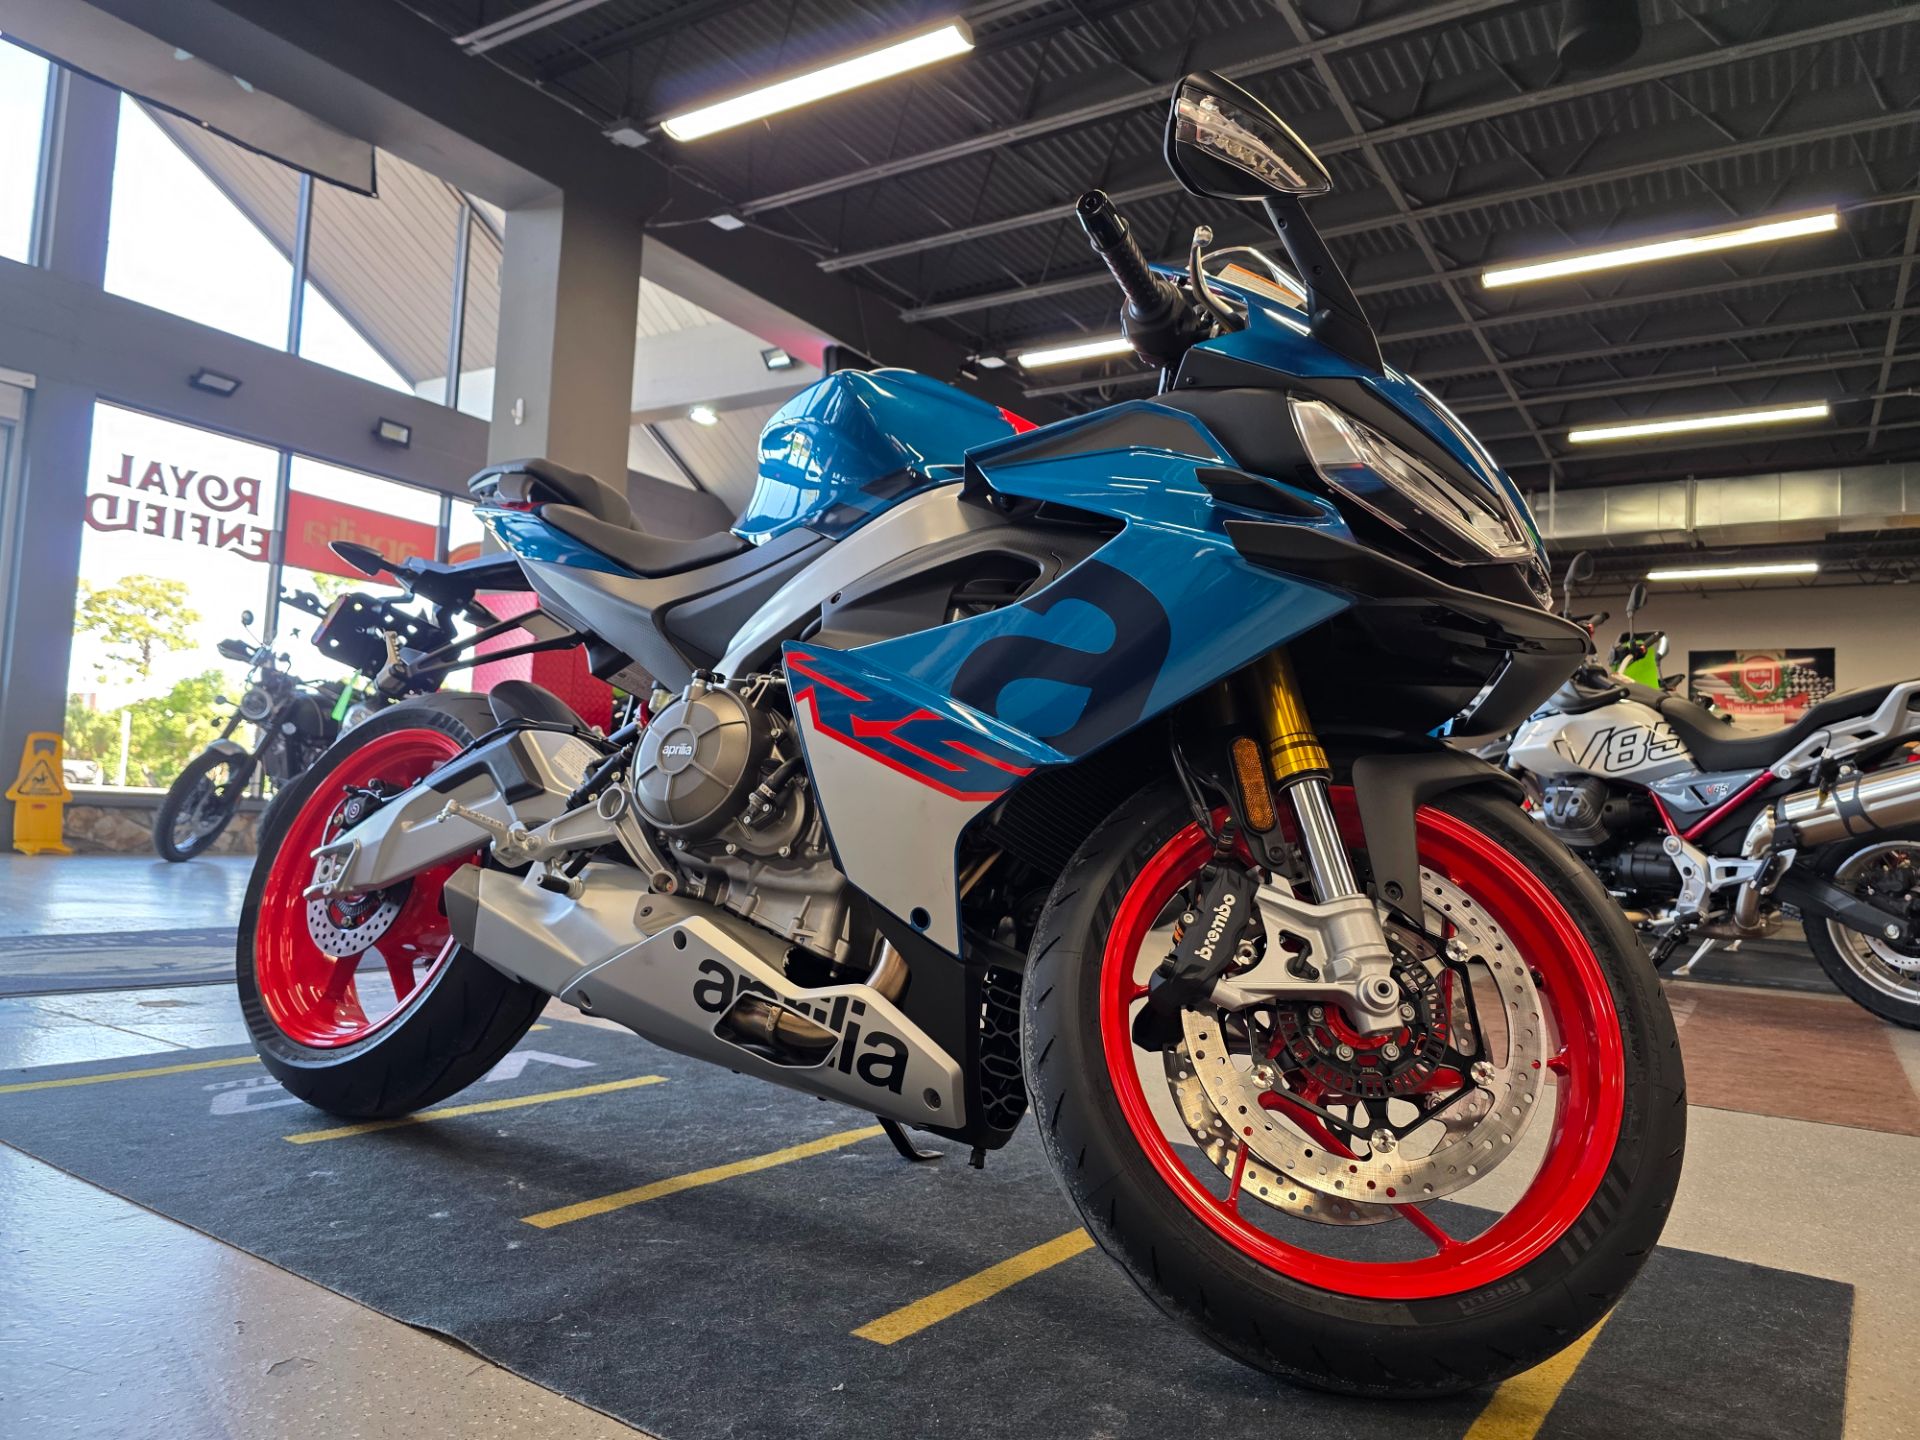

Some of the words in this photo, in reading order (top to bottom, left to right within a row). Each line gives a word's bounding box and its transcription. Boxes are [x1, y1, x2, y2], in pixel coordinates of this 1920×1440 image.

[662, 743, 692, 758] aprilia
[1553, 721, 1688, 772] V85
[1194, 894, 1236, 961] brembo
